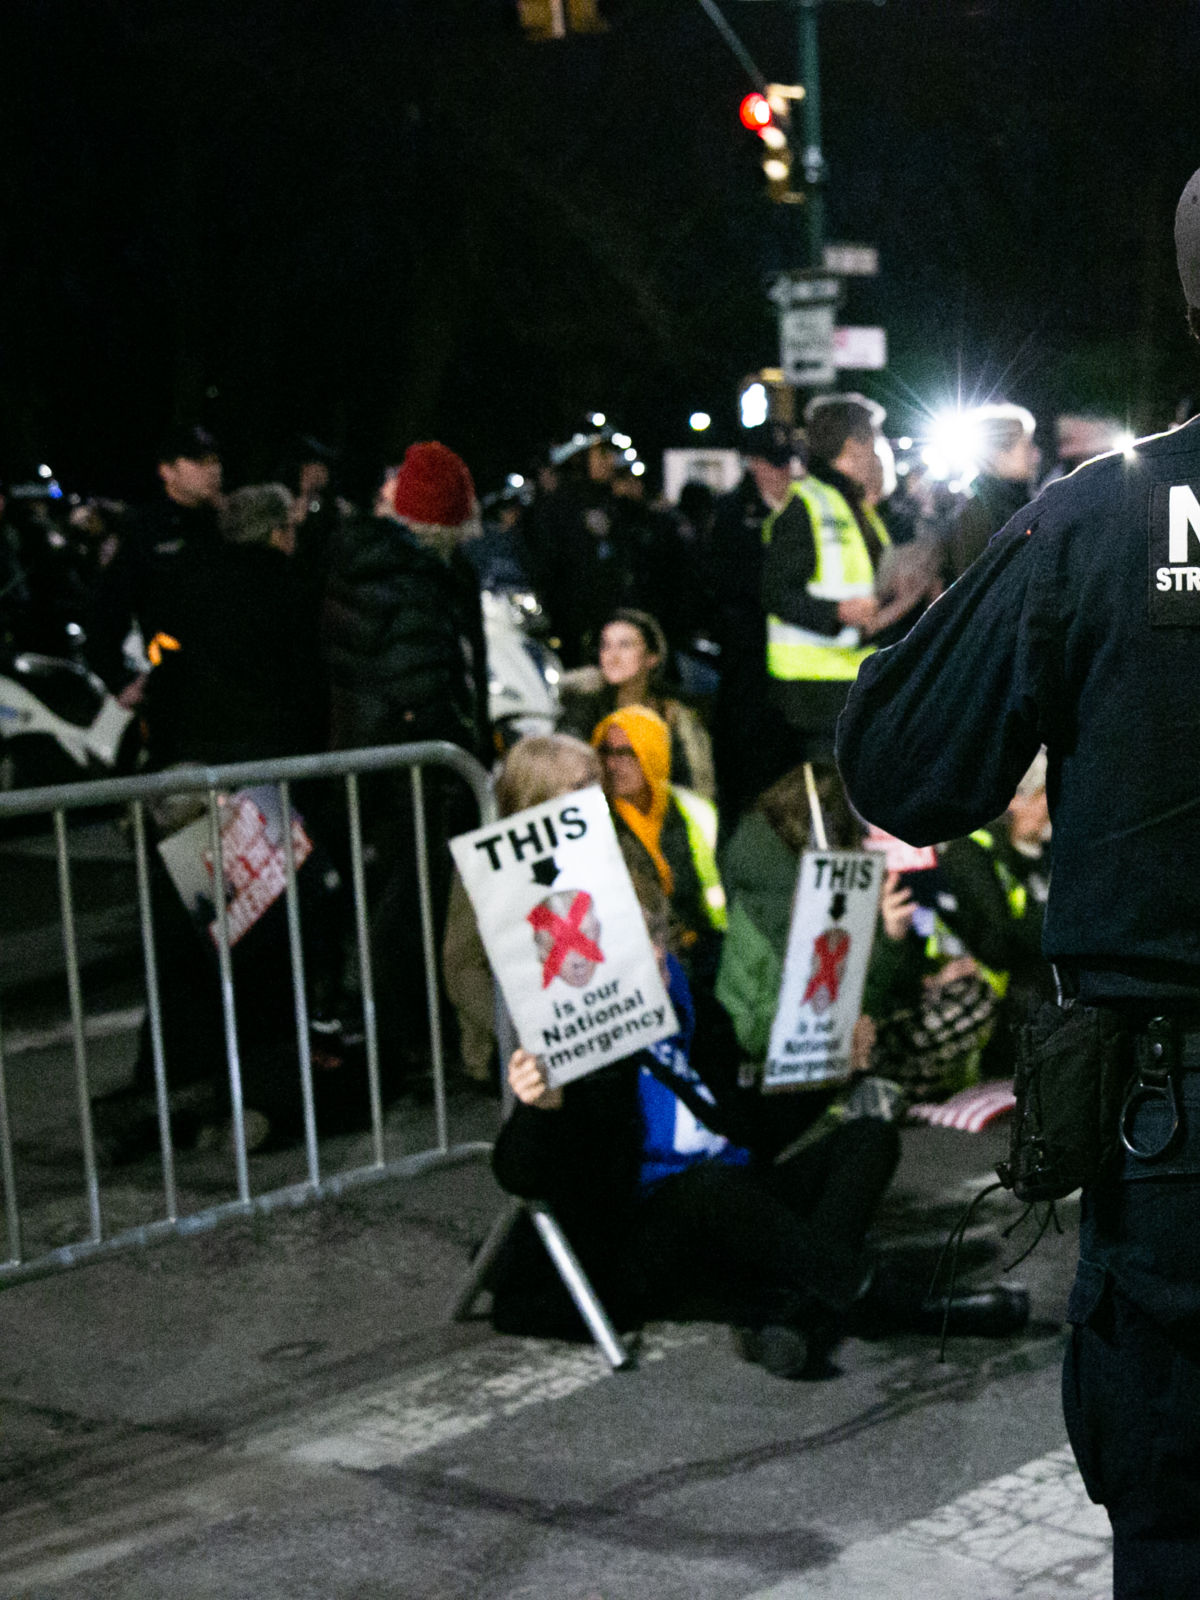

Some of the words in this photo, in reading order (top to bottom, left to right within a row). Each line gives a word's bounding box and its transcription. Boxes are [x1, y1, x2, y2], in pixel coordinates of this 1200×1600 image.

[475, 807, 588, 871] THIS
[814, 858, 875, 891] THIS
[543, 988, 644, 1047] National
[553, 1000, 576, 1019] is
[583, 979, 618, 1006] our
[550, 1006, 665, 1067] mergency
